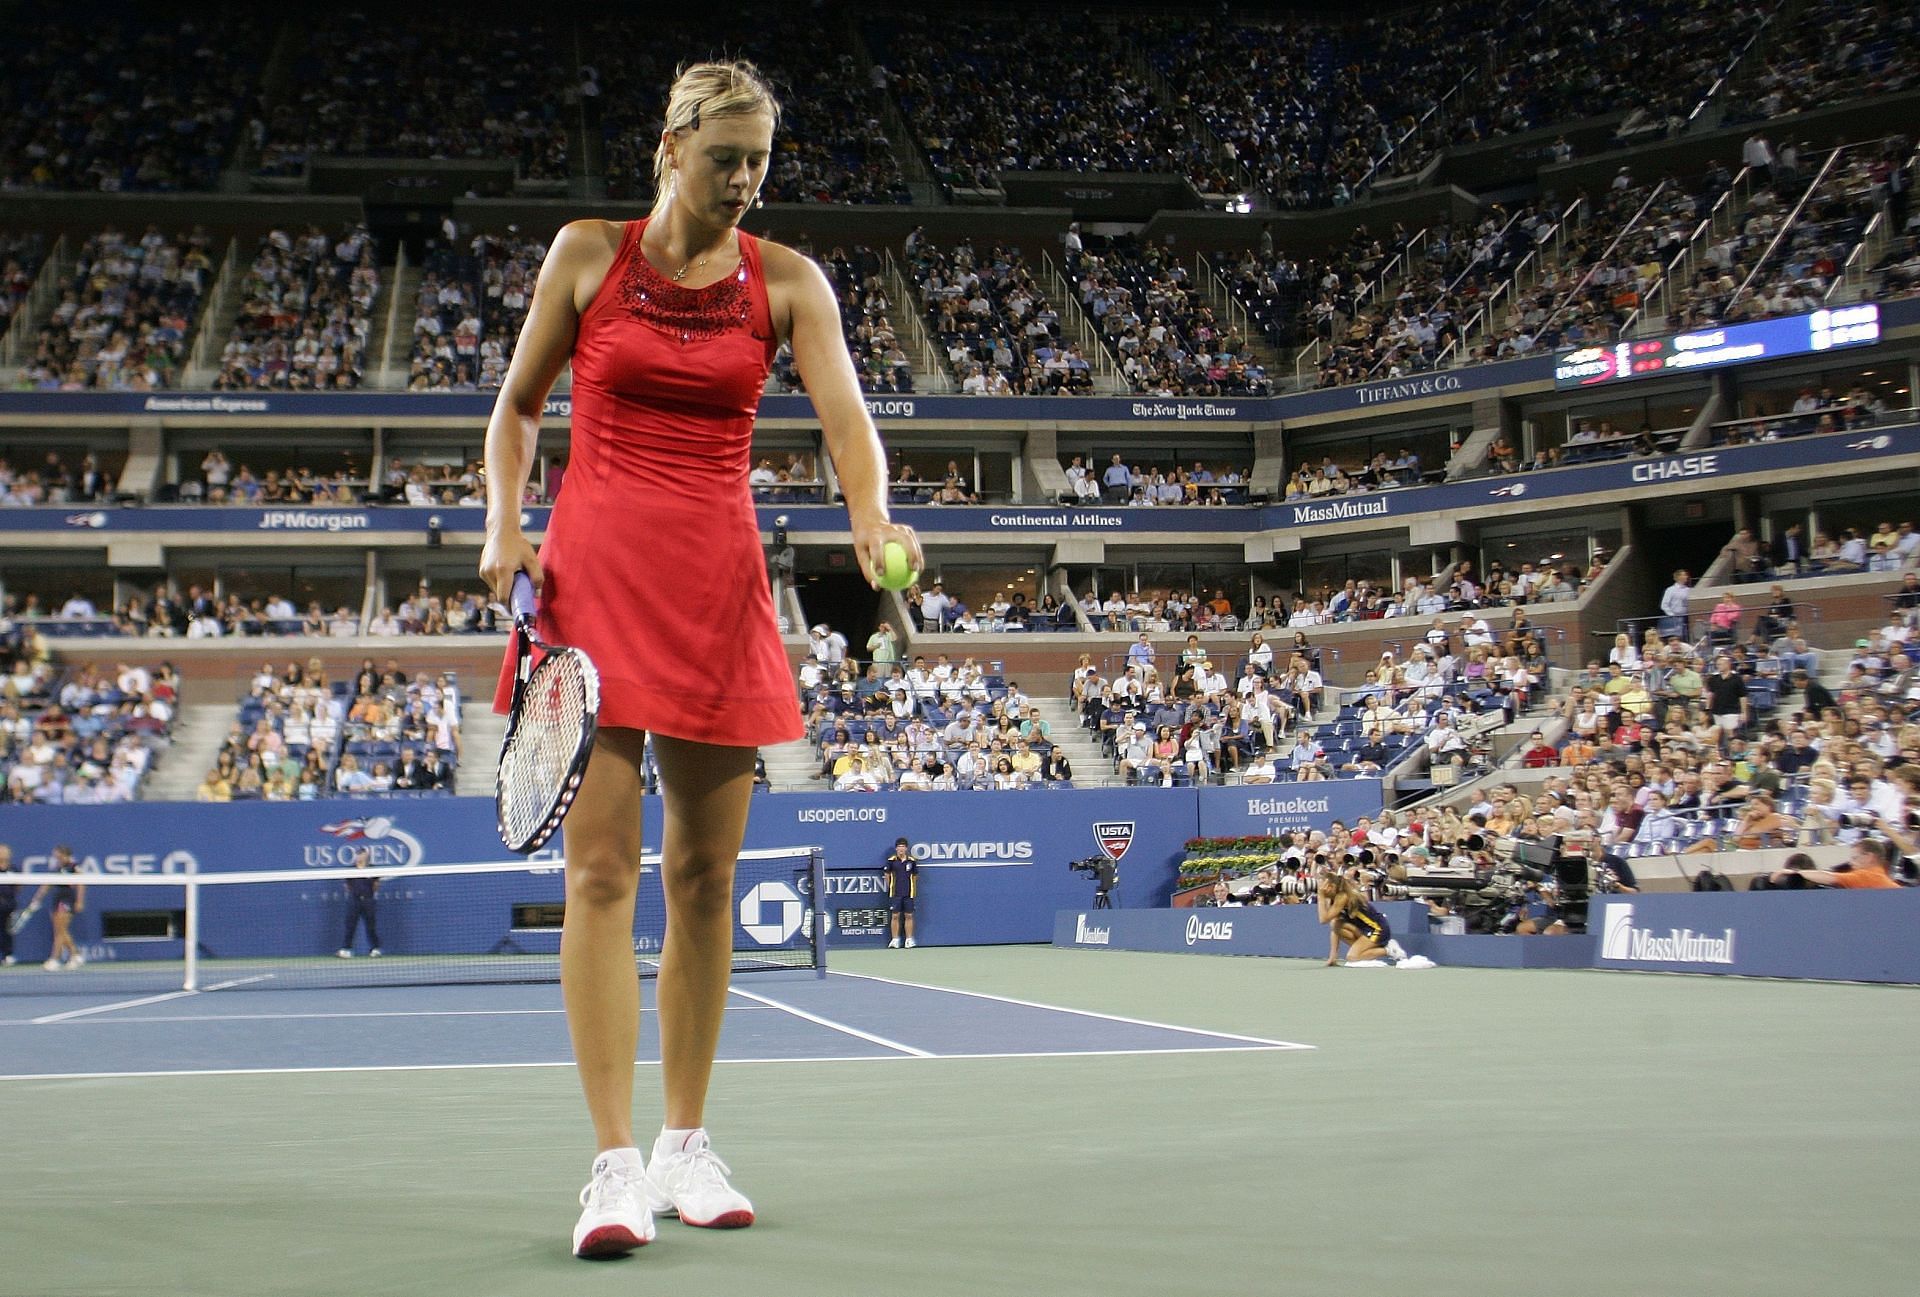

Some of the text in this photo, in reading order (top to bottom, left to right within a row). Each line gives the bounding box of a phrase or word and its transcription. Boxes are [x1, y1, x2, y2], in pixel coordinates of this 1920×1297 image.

[1356, 382, 1419, 404] TIFFANY
[1420, 379, 1433, 394] &
[1132, 403, 1237, 420] The New York Times
[1632, 455, 1720, 482] CHASE
[1293, 496, 1389, 524] MassMutual
[258, 510, 368, 531] JPMorgan
[990, 514, 1122, 526] Continental Airlines
[797, 807, 887, 824] usopen.org
[1247, 797, 1329, 816] Heineken
[1268, 815, 1308, 824] PREMIUM
[1100, 826, 1131, 836] USTA
[303, 845, 333, 867] US
[910, 841, 1033, 860] OLYMPUS
[22, 854, 157, 875] CASE
[797, 875, 888, 895] CTIZEN
[841, 928, 884, 936] MATCH TIME
[1198, 921, 1233, 940] LEXUS
[1630, 928, 1737, 965] MassMutual
